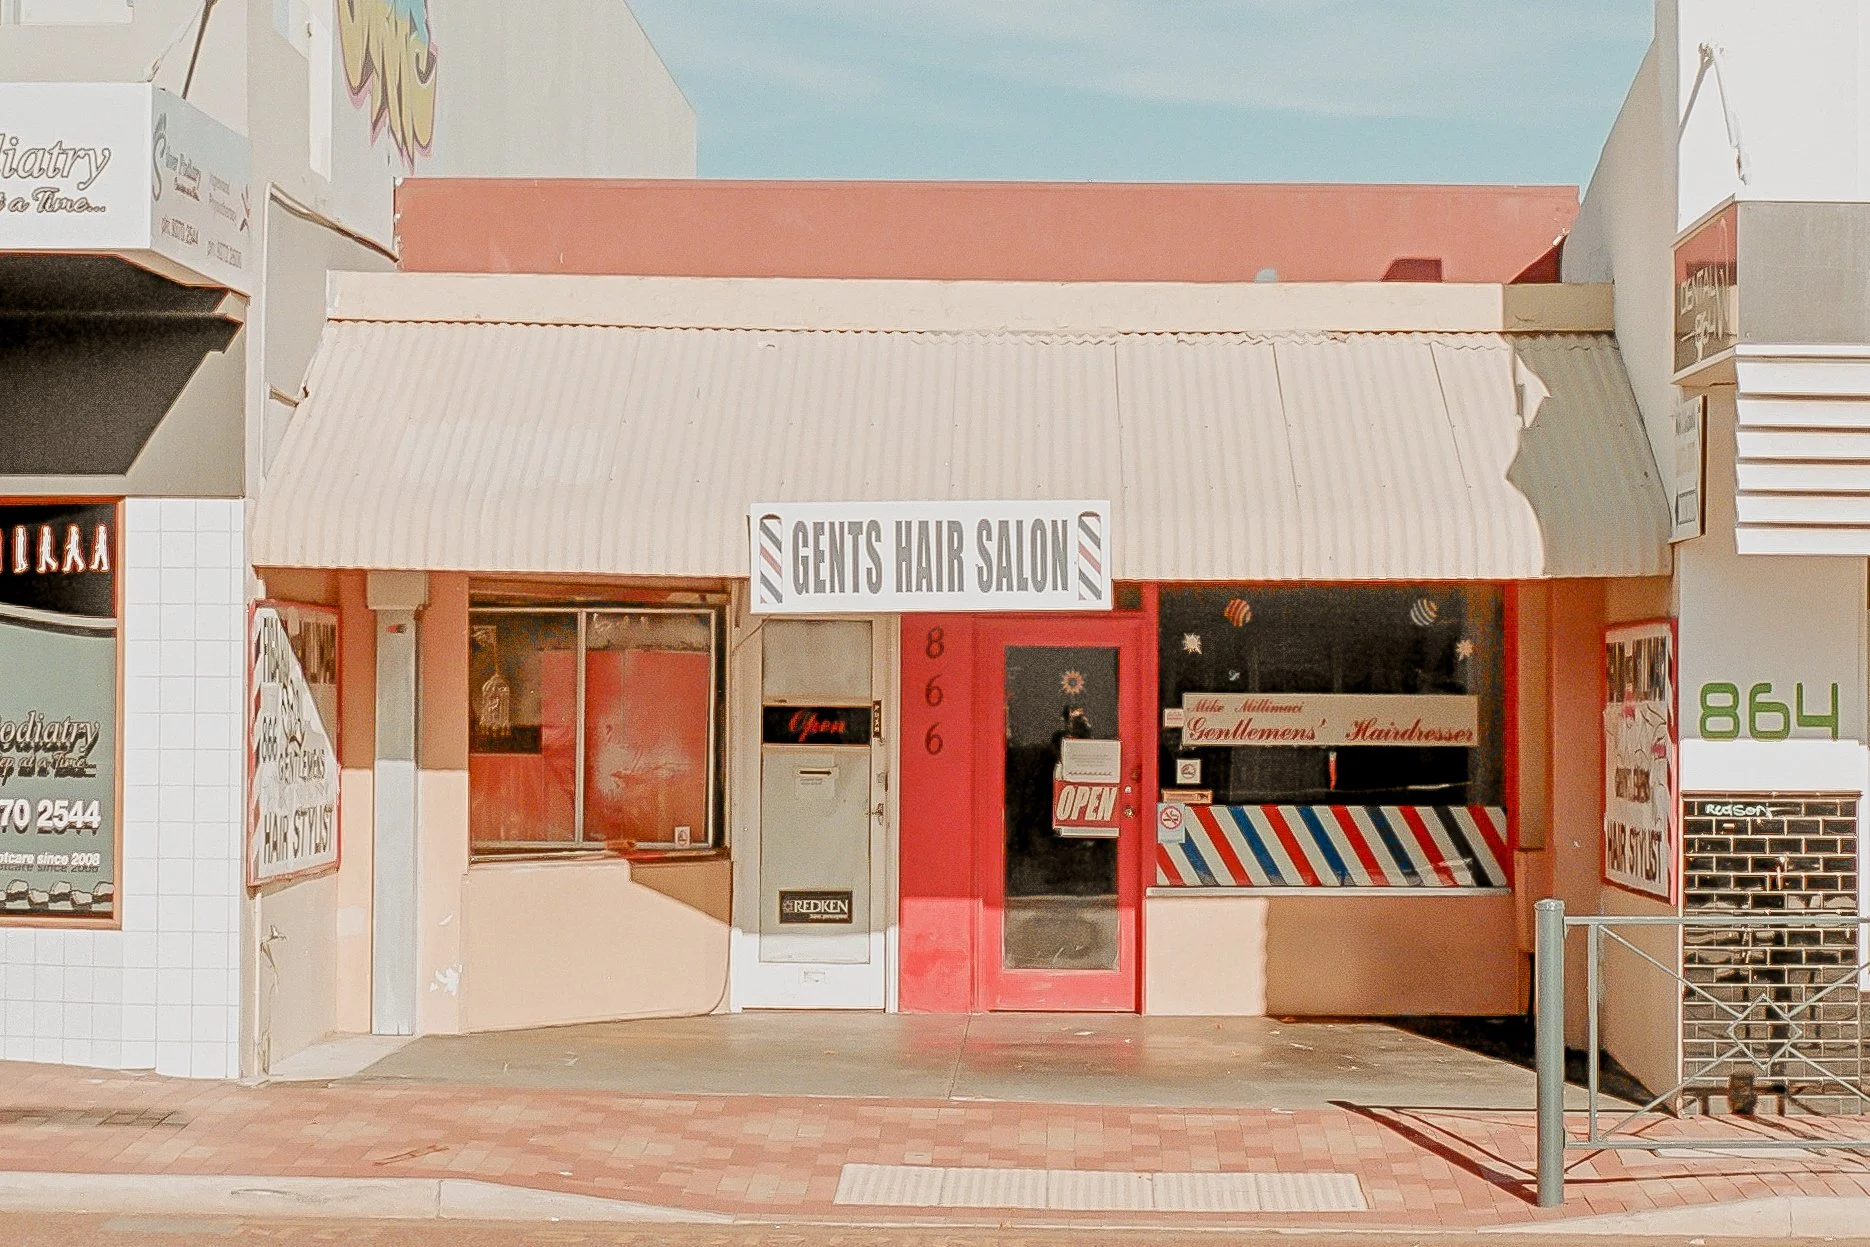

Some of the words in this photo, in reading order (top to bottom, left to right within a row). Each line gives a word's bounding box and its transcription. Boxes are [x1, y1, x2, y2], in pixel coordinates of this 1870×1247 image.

[0, 133, 111, 191] iatry
[8, 197, 30, 212] a
[792, 519, 883, 596] GENTS
[895, 519, 965, 594] HAIR
[975, 518, 1069, 594] SALON
[1187, 699, 1224, 713] Mike
[1699, 682, 1839, 741] 864
[0, 710, 100, 753] odiatry
[788, 709, 846, 742] Open
[1345, 717, 1473, 741] Hairdresser
[36, 798, 101, 832] 2544
[1056, 785, 1119, 822] OPEN
[263, 812, 288, 865] HAIR
[293, 804, 334, 859] STYLIST
[1607, 820, 1627, 874] HAIR
[1629, 825, 1662, 884] STYLIST
[36, 851, 69, 865] since
[70, 852, 100, 866] 2008
[794, 899, 848, 913] REDKEN
